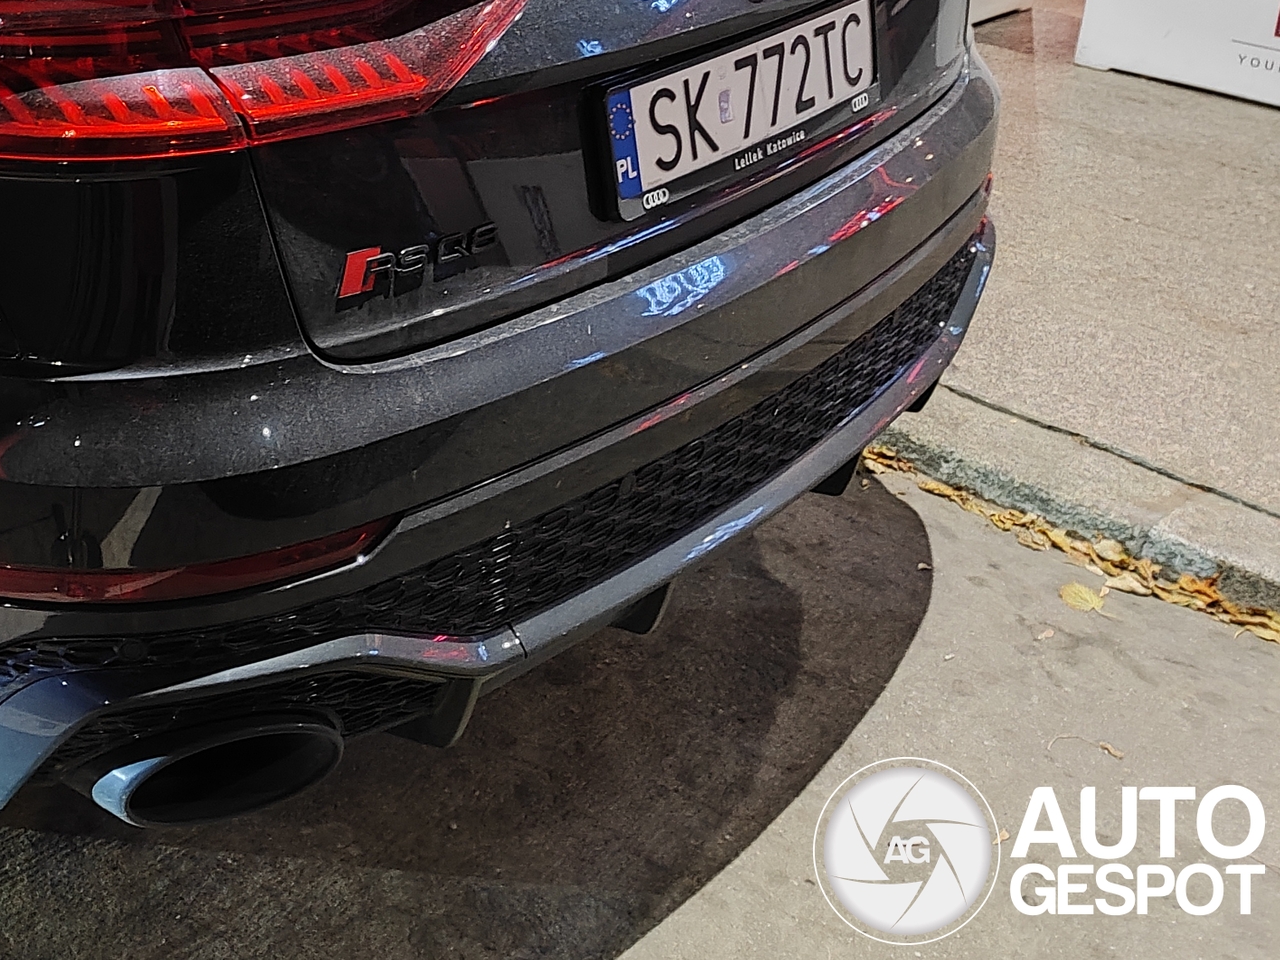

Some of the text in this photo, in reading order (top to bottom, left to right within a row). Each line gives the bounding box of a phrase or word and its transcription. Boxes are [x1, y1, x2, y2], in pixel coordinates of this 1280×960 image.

[1238, 53, 1280, 73] YOU
[648, 12, 864, 172] SK 772TC
[734, 128, 806, 171] Lellek Katowice
[615, 157, 638, 184] PL
